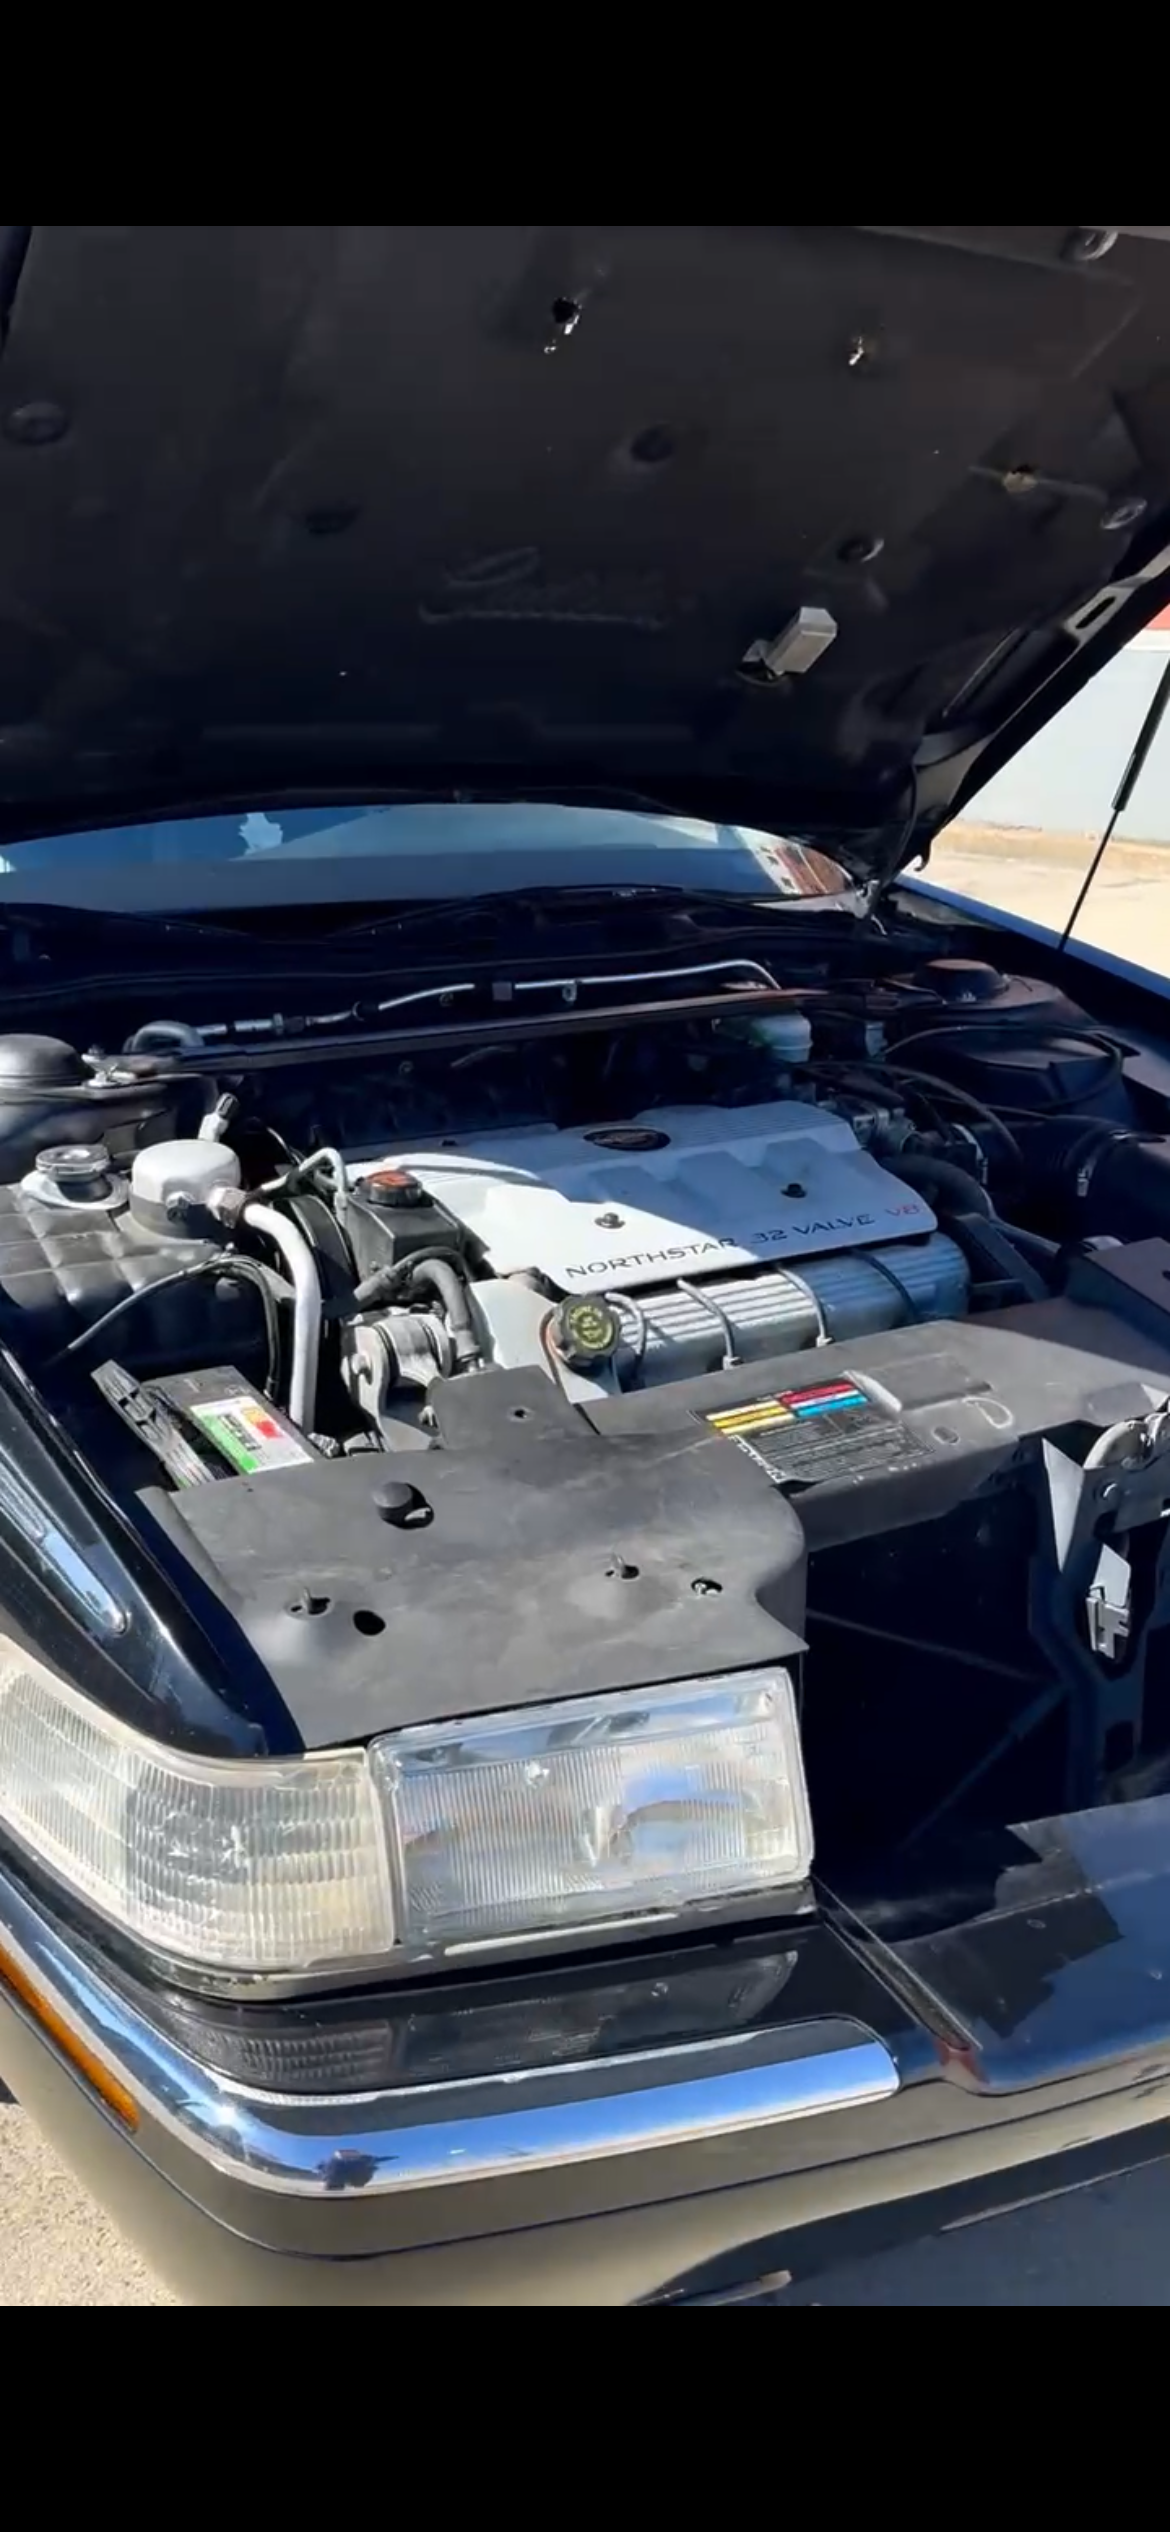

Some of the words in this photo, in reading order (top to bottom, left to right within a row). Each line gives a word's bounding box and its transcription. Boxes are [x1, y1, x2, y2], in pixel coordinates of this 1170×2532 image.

[565, 1237, 738, 1278] NORTHSTAR
[752, 1230, 788, 1244] 32
[792, 1214, 875, 1235] VALVE
[885, 1204, 920, 1217] V8
